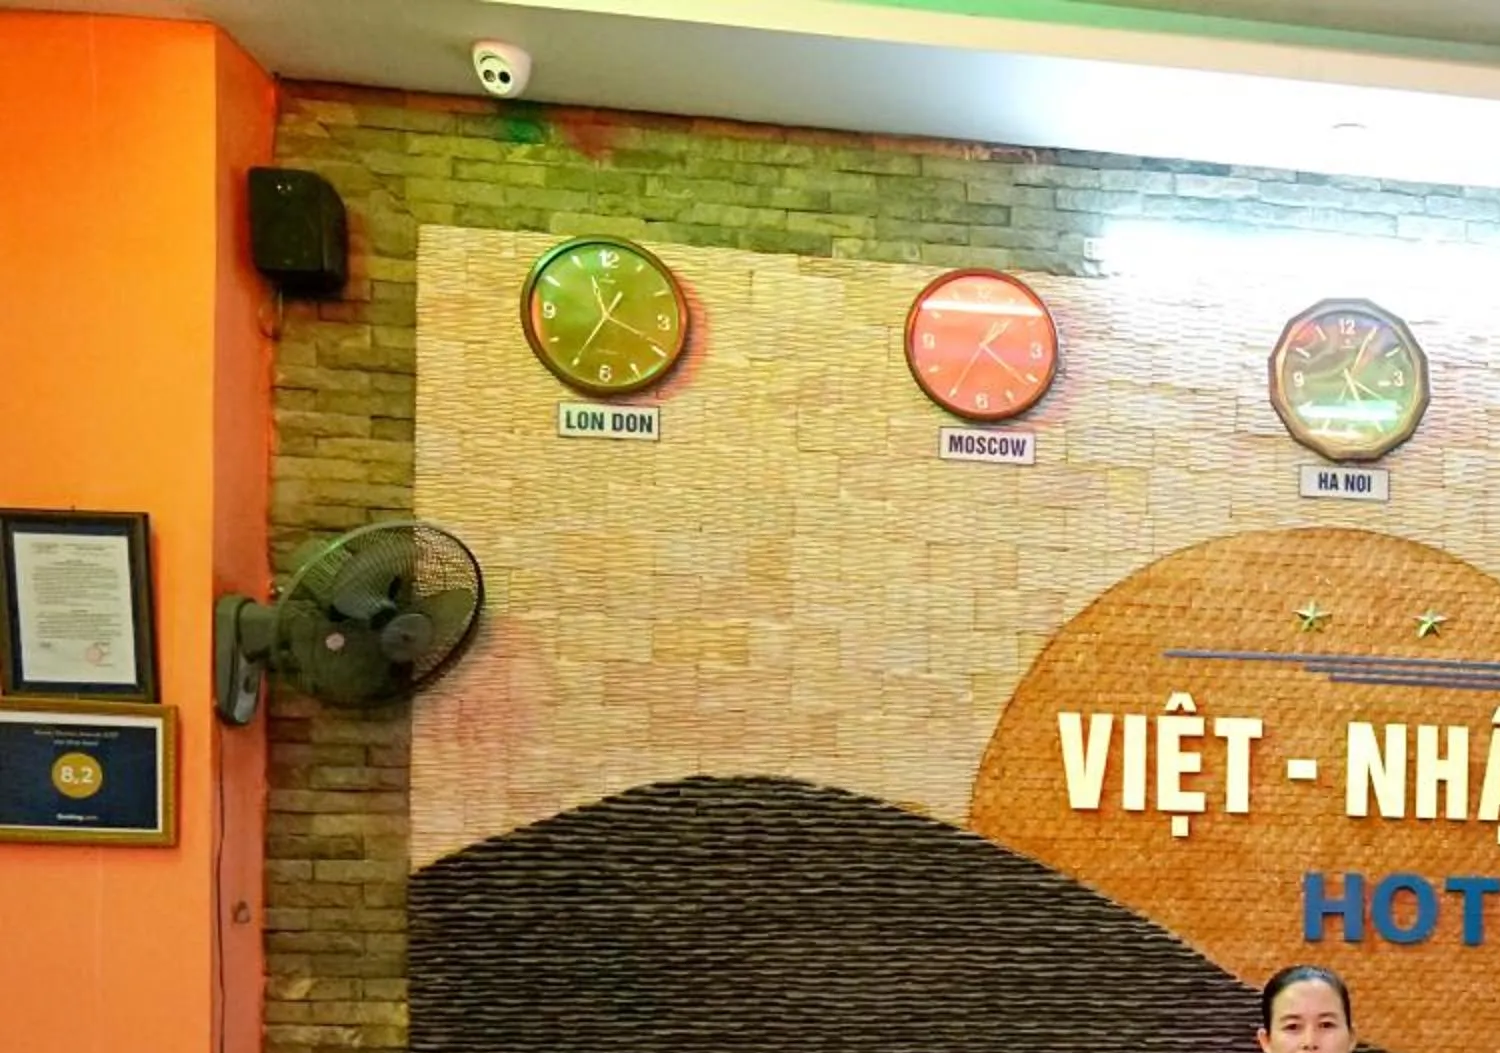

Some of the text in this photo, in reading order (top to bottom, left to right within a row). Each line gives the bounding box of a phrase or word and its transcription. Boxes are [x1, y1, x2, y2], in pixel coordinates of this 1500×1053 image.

[598, 249, 620, 269] 12
[543, 301, 557, 319] 9
[657, 313, 671, 331] 3
[1338, 318, 1356, 335] 12
[1293, 371, 1305, 388] 9
[565, 410, 653, 433] LON DON
[948, 434, 1027, 456] MOSCOW
[1318, 472, 1371, 493] HA NOI
[1058, 691, 1263, 837] VIỆT
